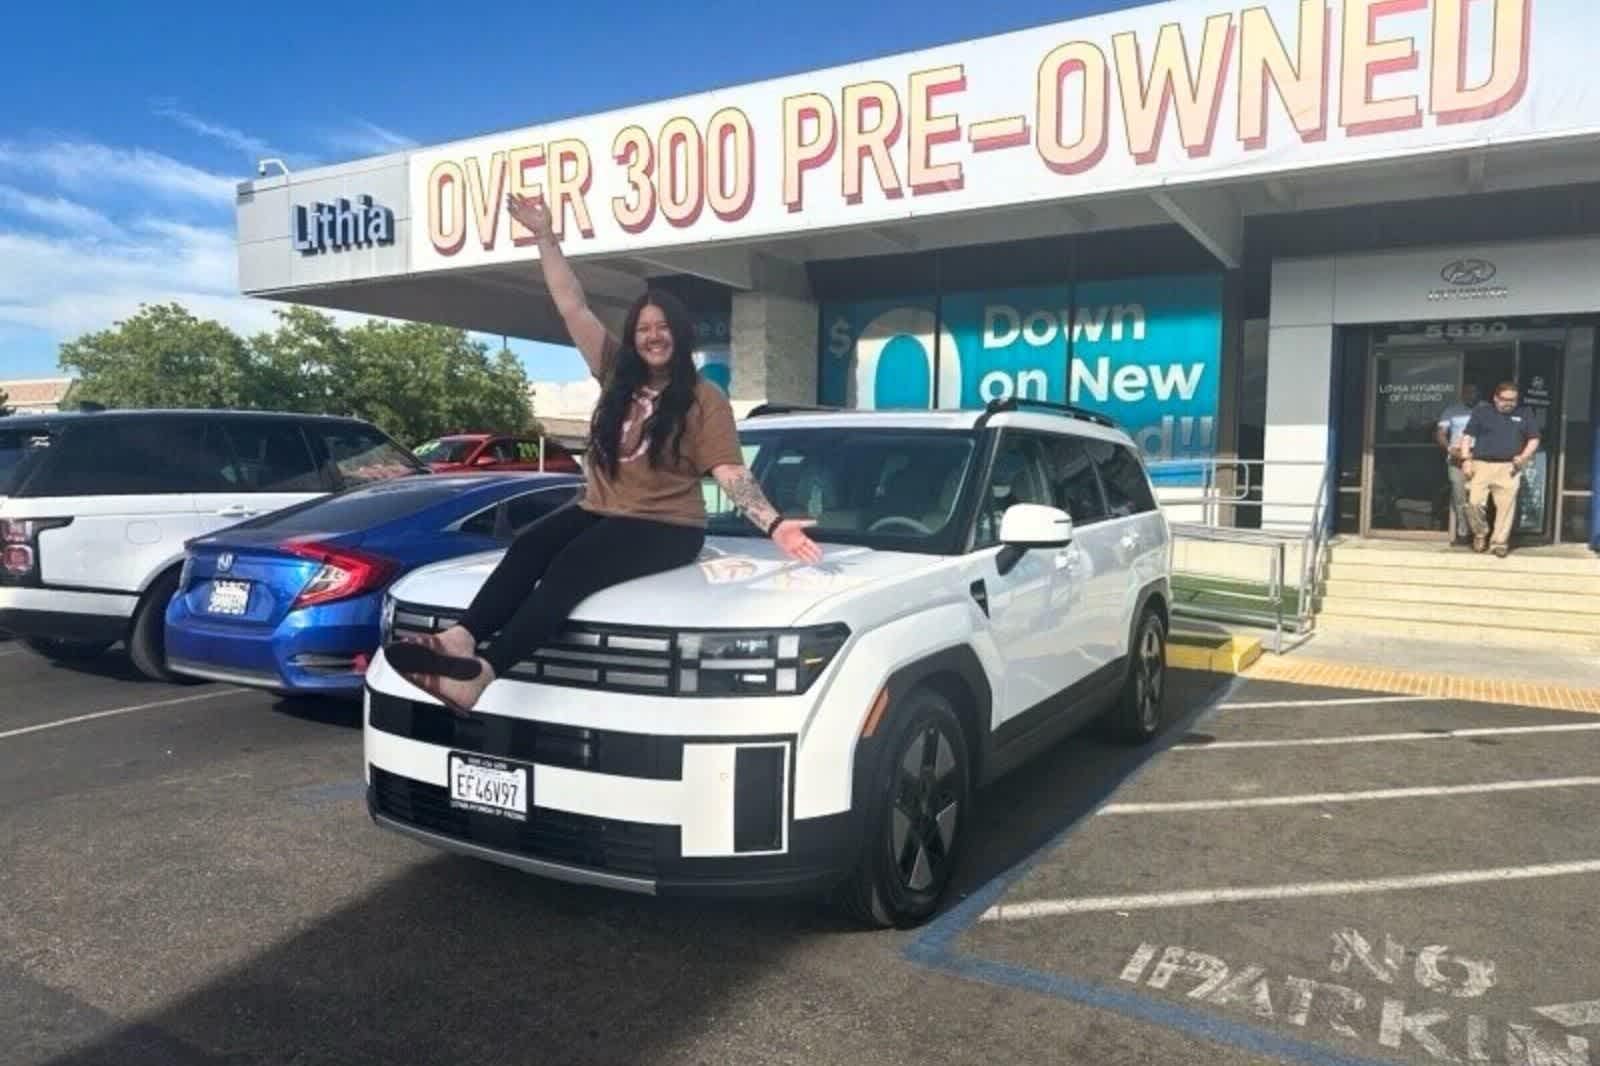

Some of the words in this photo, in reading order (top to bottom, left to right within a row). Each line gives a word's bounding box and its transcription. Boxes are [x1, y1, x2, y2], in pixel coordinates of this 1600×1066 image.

[427, 137, 596, 257] OVER
[611, 106, 756, 234] 300
[781, 0, 1529, 213] PRE-OWNED
[291, 193, 395, 256] Lithia
[983, 302, 1146, 349] Down
[979, 368, 1048, 405] on
[1070, 355, 1205, 402] New
[1329, 928, 1497, 998] NO
